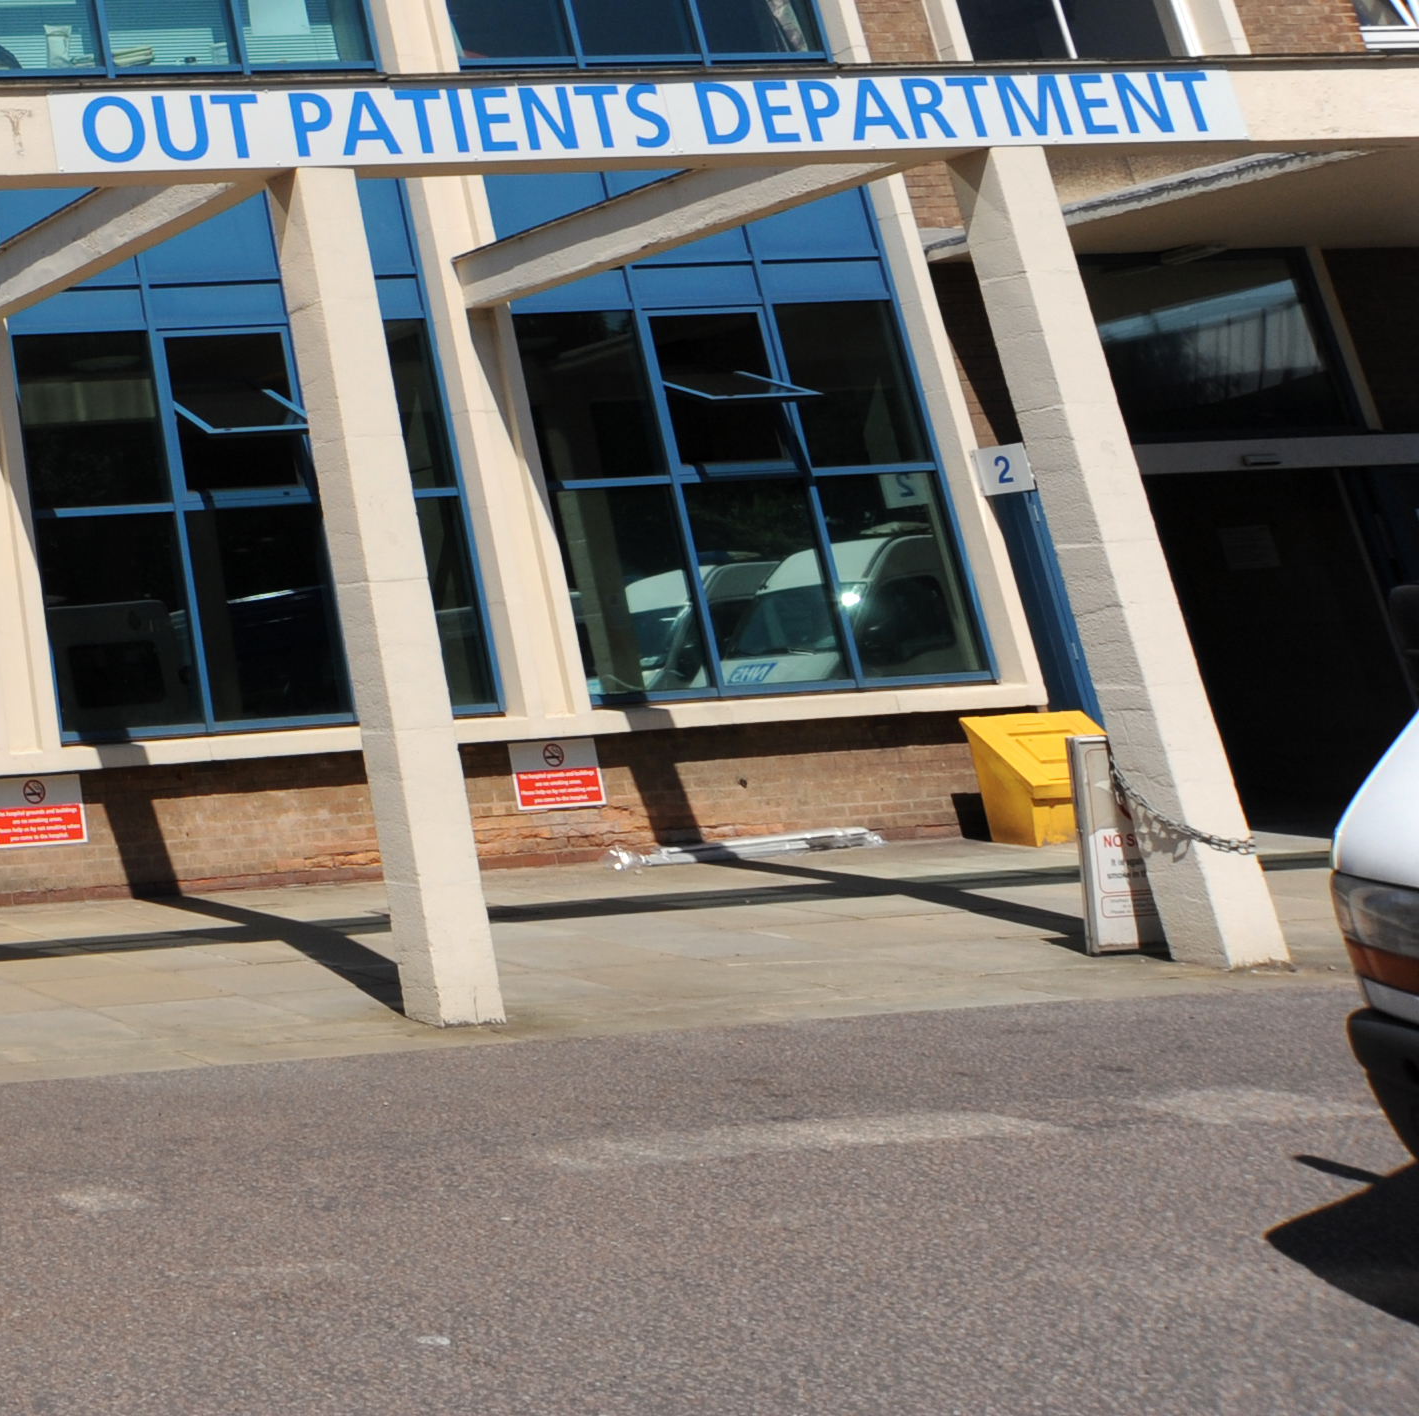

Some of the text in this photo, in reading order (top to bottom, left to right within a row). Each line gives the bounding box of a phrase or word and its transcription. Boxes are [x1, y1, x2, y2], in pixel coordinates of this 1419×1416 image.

[82, 70, 1210, 163] OUT PATIENTS DEPARTMENT
[994, 455, 1014, 484] 2
[1103, 834, 1123, 848] NO
